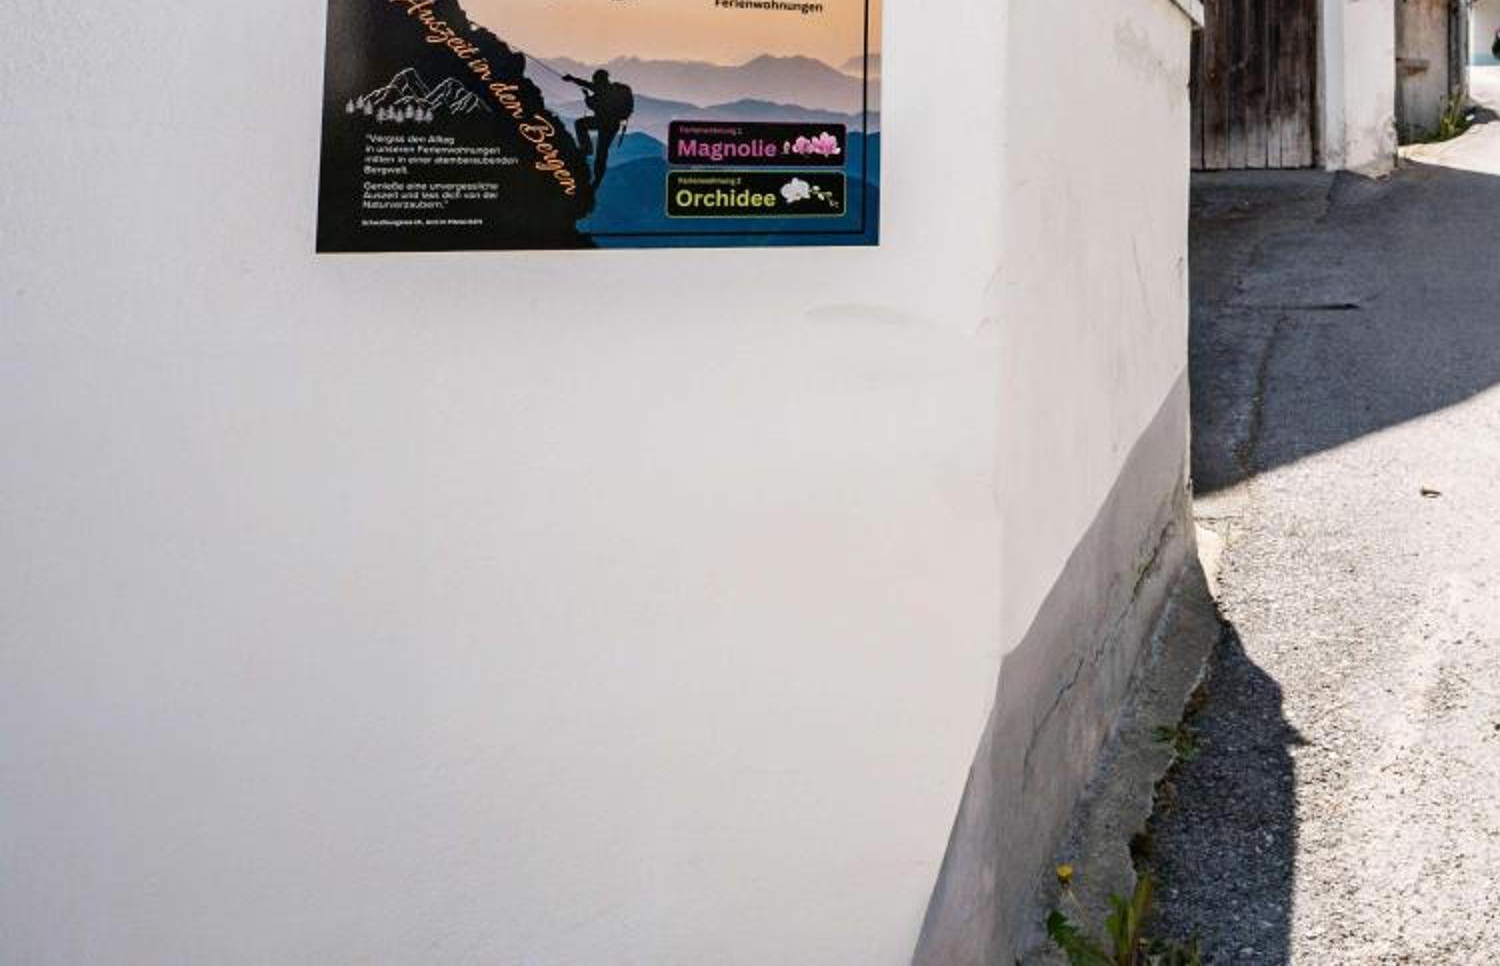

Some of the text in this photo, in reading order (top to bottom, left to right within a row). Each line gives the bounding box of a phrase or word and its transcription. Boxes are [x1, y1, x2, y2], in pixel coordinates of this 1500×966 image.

[489, 81, 524, 119] den
[519, 114, 577, 196] Bergen
[677, 139, 777, 161] Magnolie
[675, 188, 777, 208] Orchidee
